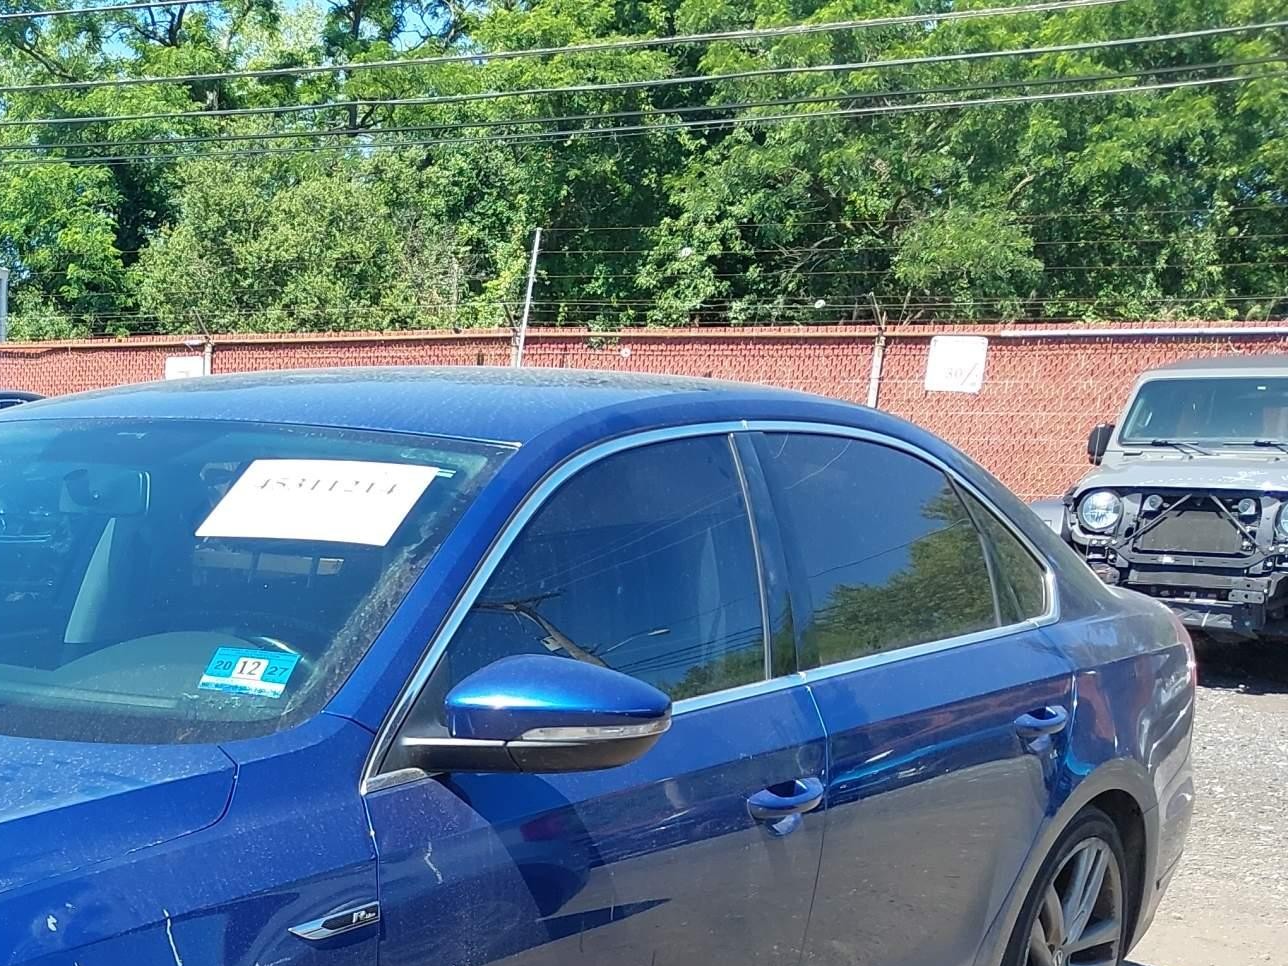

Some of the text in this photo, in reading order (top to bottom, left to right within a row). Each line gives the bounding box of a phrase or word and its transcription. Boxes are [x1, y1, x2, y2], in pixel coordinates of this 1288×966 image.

[214, 660, 289, 677] 20 12 27
